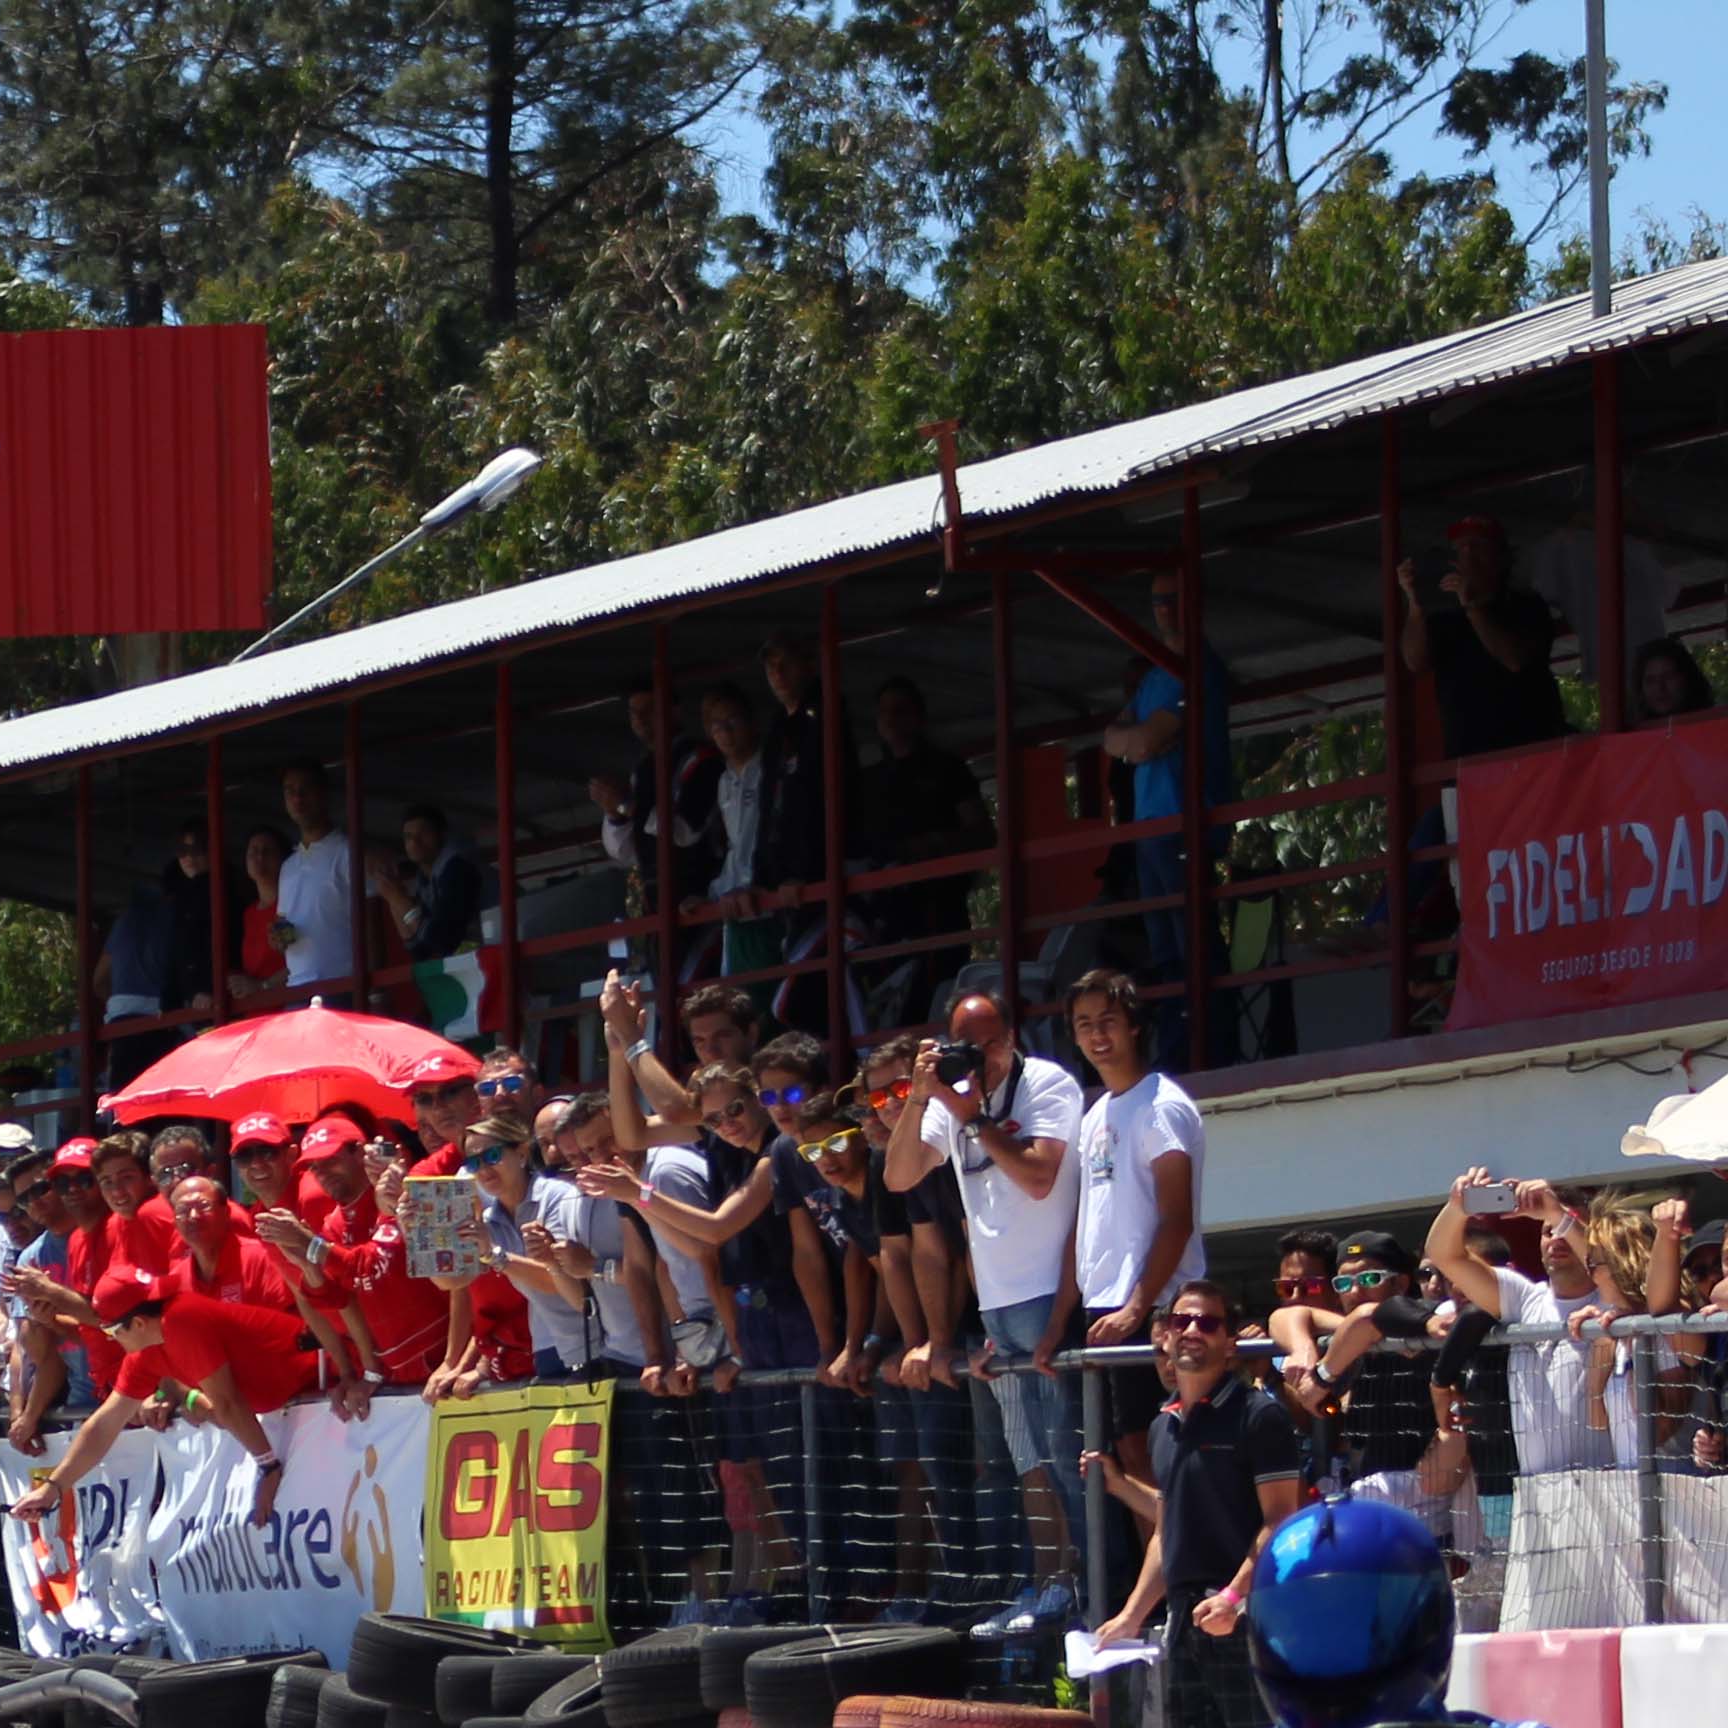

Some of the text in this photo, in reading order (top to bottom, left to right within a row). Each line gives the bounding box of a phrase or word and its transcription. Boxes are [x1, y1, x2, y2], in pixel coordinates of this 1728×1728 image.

[1541, 953, 1596, 985] SEGUROS
[440, 1422, 602, 1541] GAS
[435, 1562, 598, 1607] RACING TEAM
